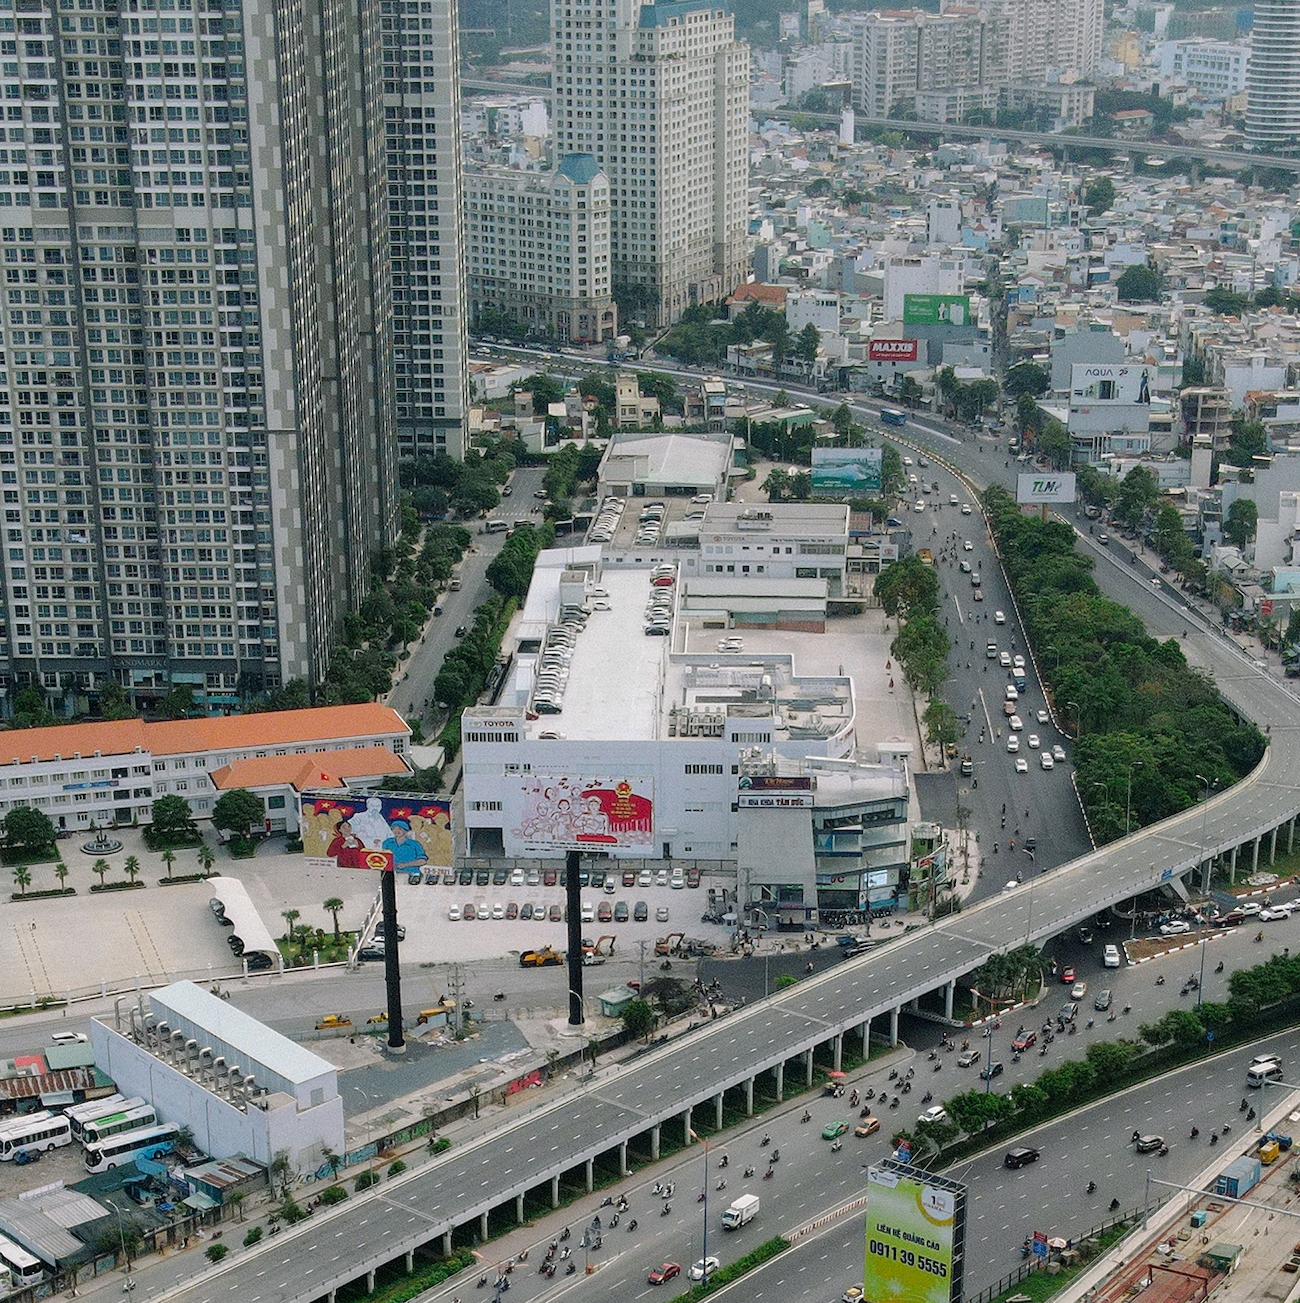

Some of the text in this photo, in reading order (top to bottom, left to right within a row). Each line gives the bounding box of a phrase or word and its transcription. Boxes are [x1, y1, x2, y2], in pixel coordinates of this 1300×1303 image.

[872, 342, 914, 352] MAXXIS
[1085, 368, 1113, 376] AQUA
[876, 1223, 891, 1236] LIÊN
[869, 1239, 947, 1278] 0911 39 5555
